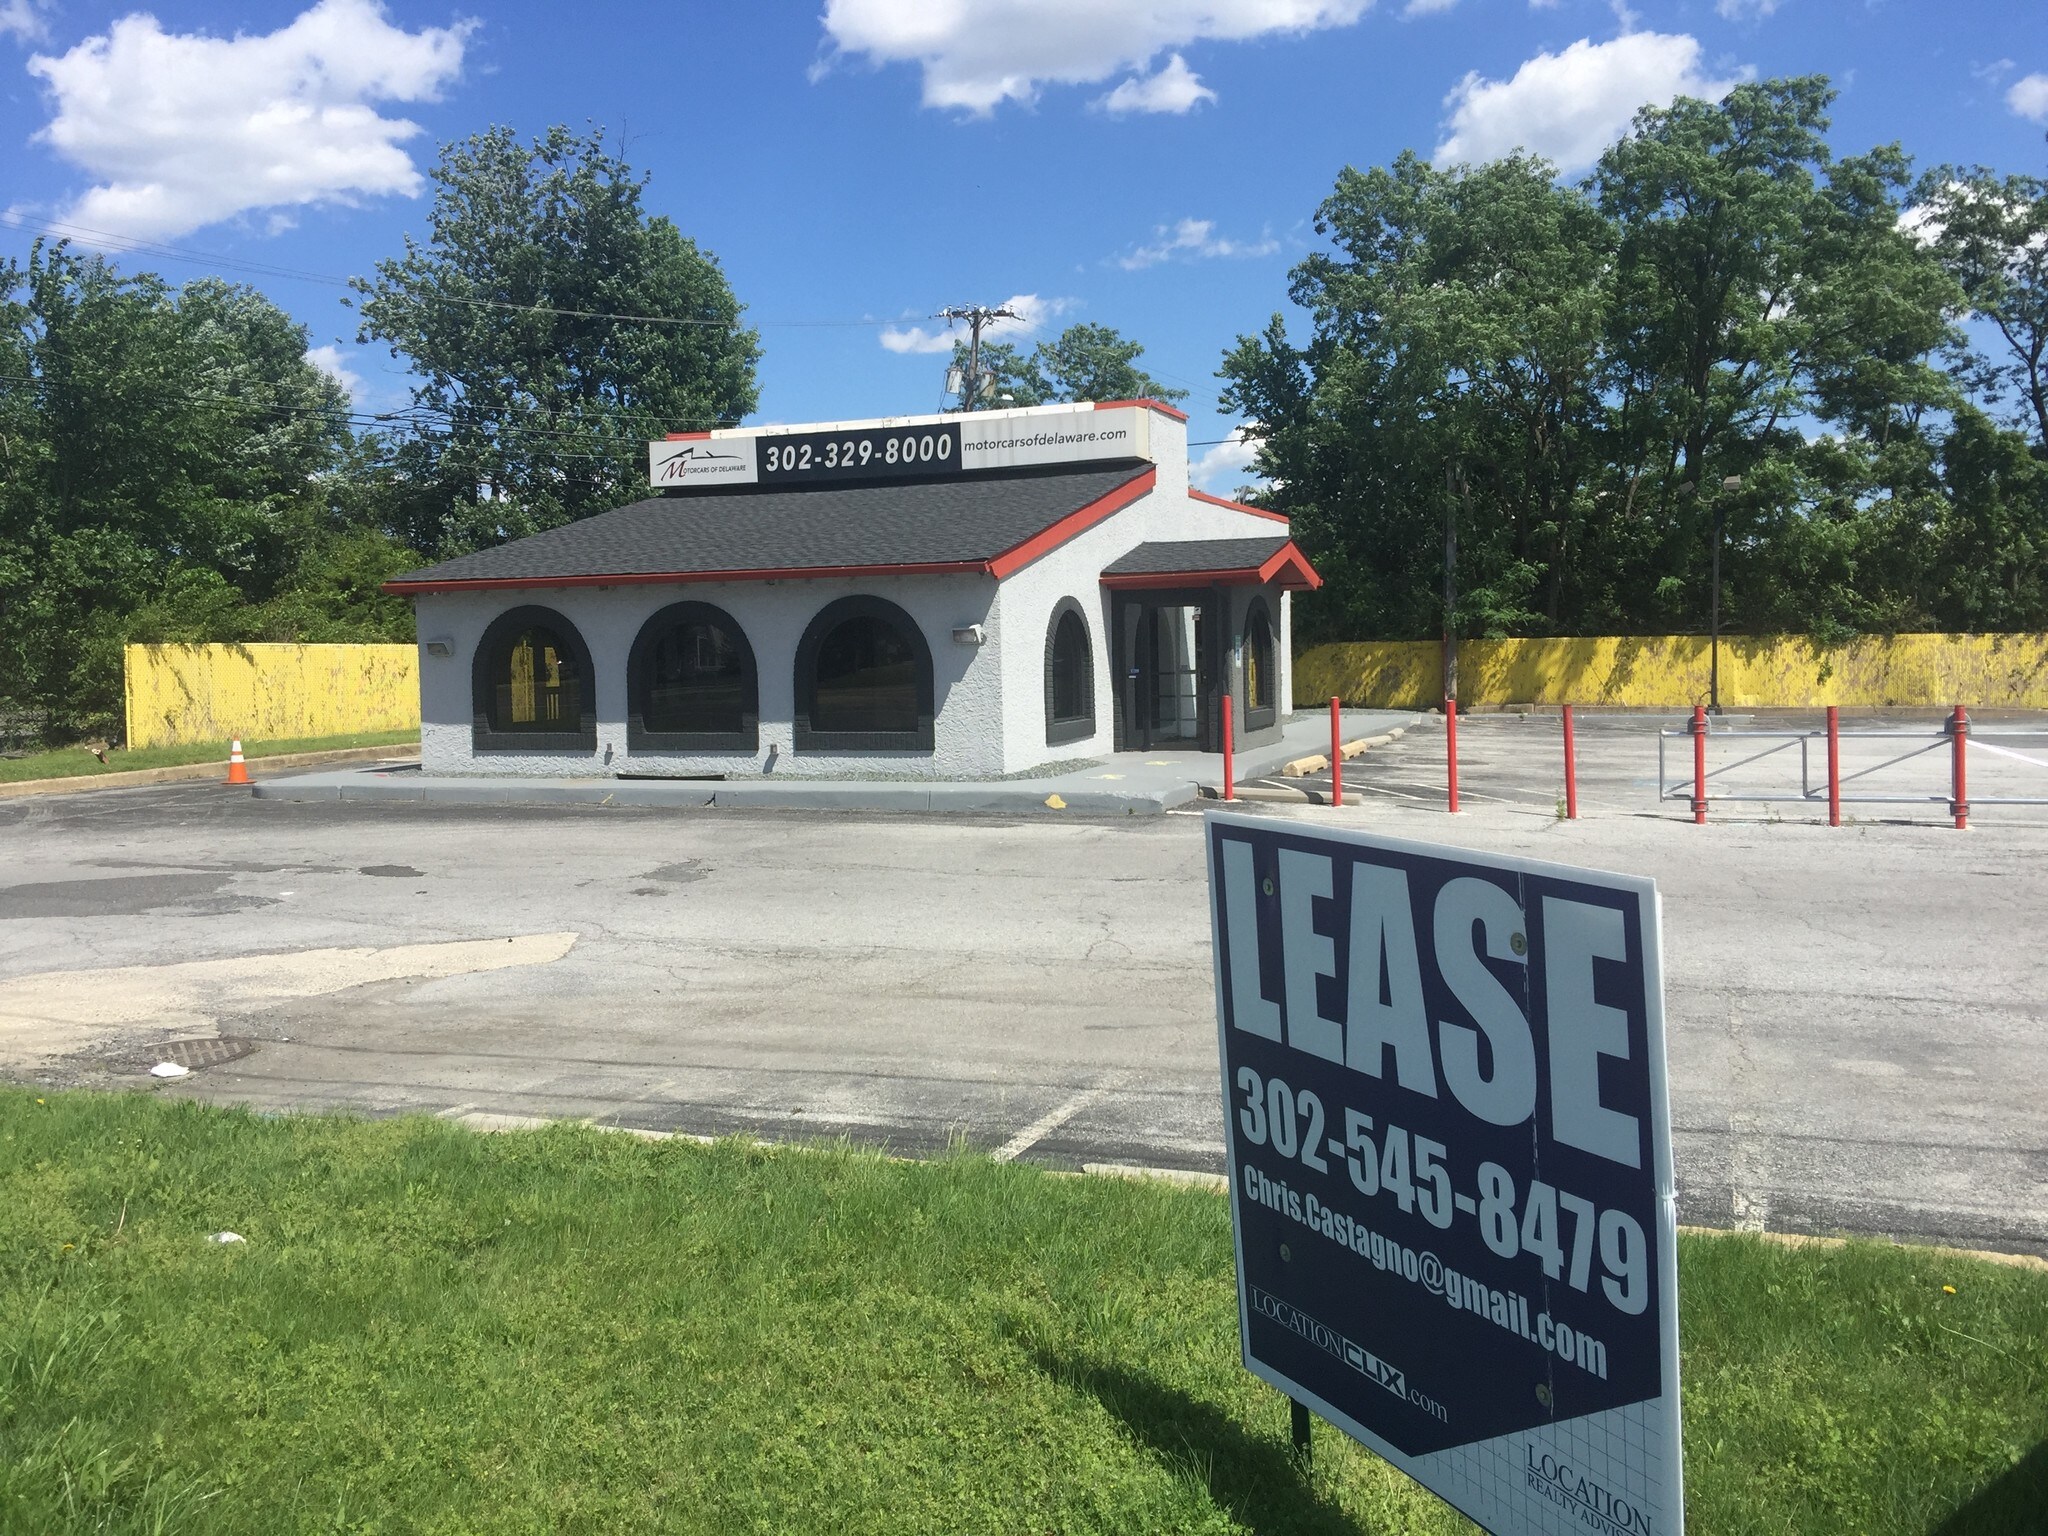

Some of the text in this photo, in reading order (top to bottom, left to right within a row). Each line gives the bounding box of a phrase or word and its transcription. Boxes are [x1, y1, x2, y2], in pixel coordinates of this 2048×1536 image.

[766, 433, 952, 472] 302-329-8000
[964, 429, 1127, 451] motorcarsofdelaware.com
[1222, 838, 1641, 1169] LEASE
[1236, 1066, 1649, 1316] 302-545-8479
[1244, 1164, 1608, 1381] Chris.Castagno@gmail.com
[1527, 1443, 1652, 1536] LOCATION
[1527, 1472, 1578, 1515] REALTY
